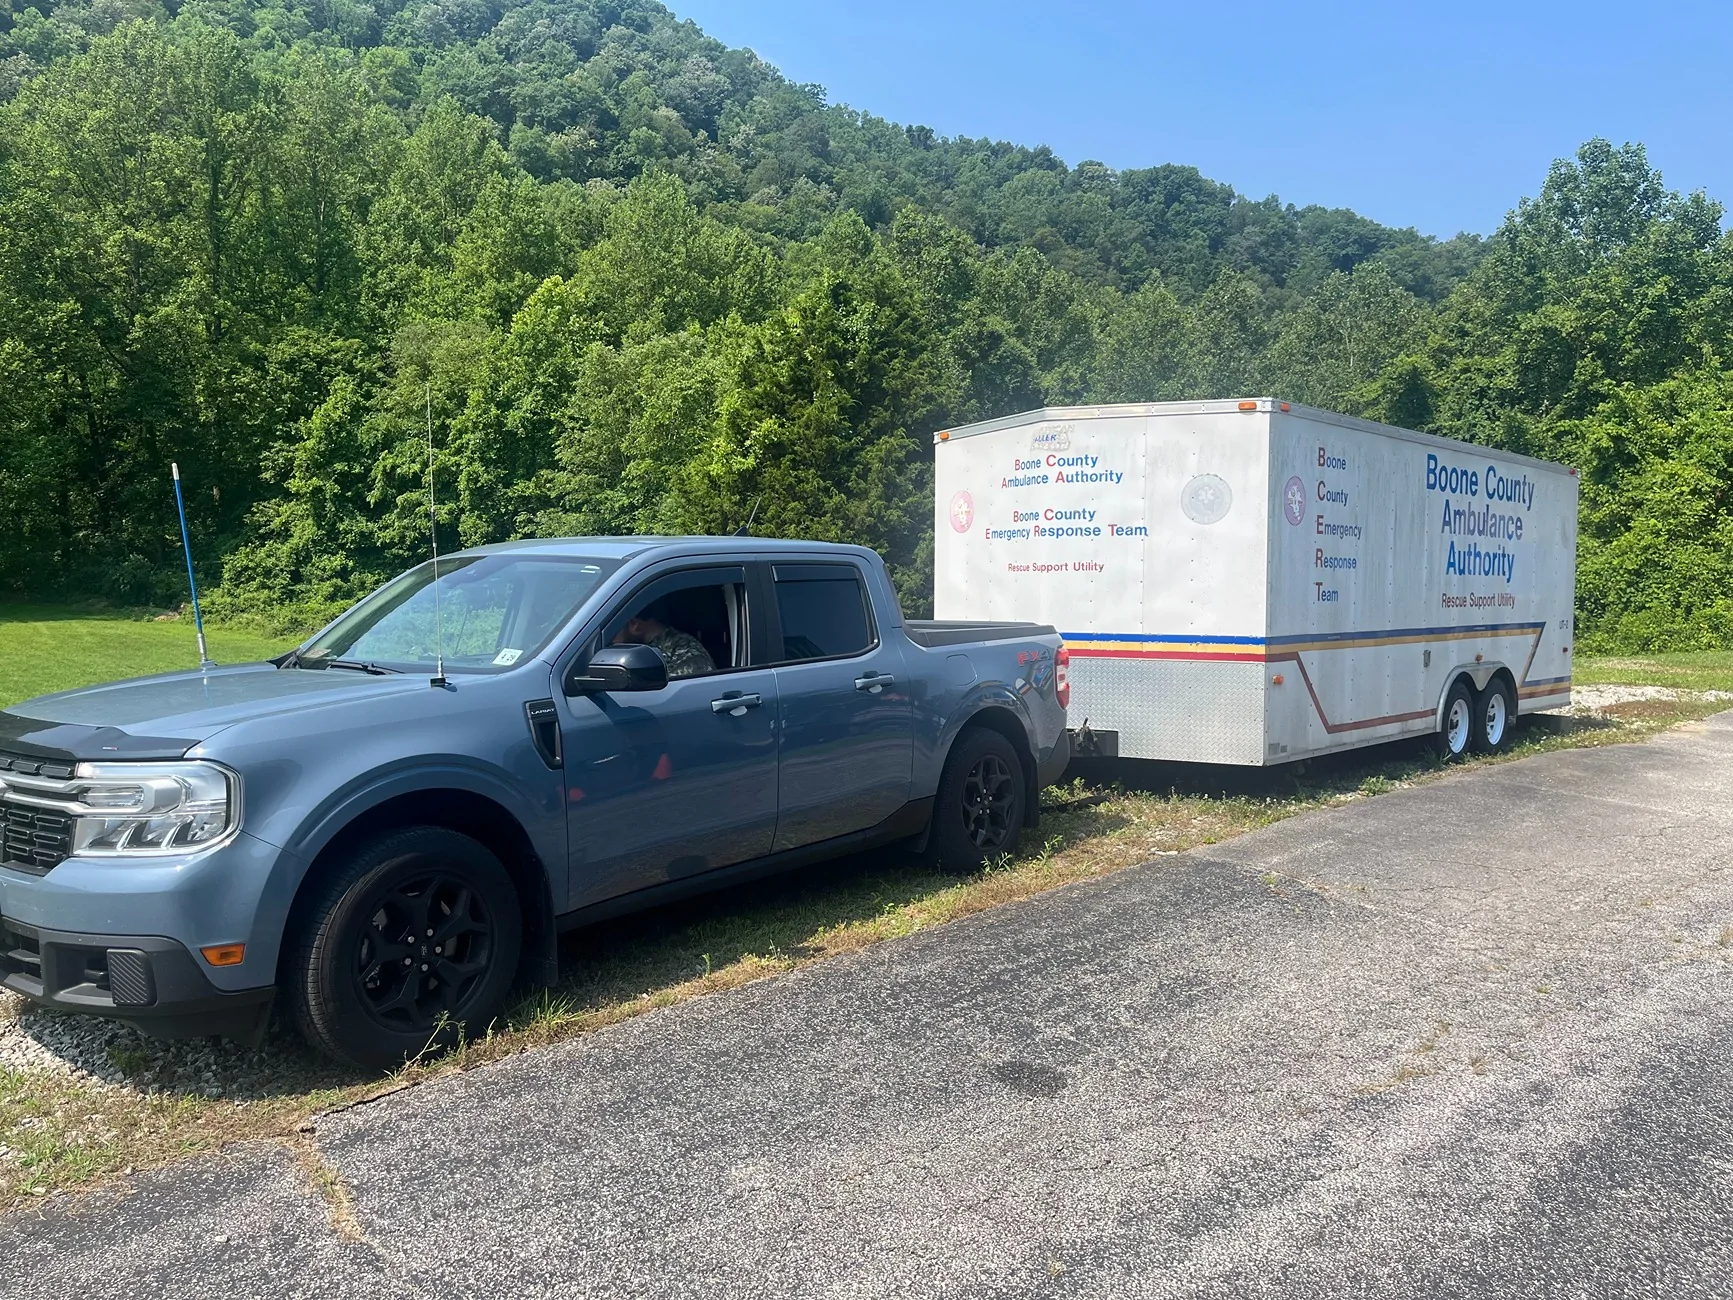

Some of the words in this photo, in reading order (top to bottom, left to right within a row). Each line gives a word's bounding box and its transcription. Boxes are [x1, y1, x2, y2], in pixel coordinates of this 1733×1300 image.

[1014, 458, 1041, 471] Boone
[1046, 454, 1099, 470] County
[1317, 447, 1347, 471] Boone
[1001, 474, 1049, 489] Ambulance
[1055, 470, 1123, 484] Authority
[1426, 453, 1479, 497] Boone
[1485, 465, 1535, 512] County
[1317, 480, 1349, 507] County
[1013, 511, 1040, 523] Boone
[1044, 508, 1096, 522] County
[1441, 499, 1524, 541] Ambulance
[985, 528, 1031, 540] Emergency
[1034, 525, 1101, 538] Response
[1108, 523, 1149, 537] Team
[1316, 515, 1362, 539] Emergency
[1008, 563, 1030, 573] Rescue
[1032, 562, 1069, 573] Support
[1073, 561, 1105, 572] Utility
[1315, 548, 1357, 571] Response
[1446, 541, 1515, 584] Authority
[1315, 582, 1339, 602] Team
[1441, 593, 1467, 609] Rescue
[1469, 592, 1497, 610] Support
[1497, 593, 1516, 609] Utility
[1017, 649, 1051, 666] FX4
